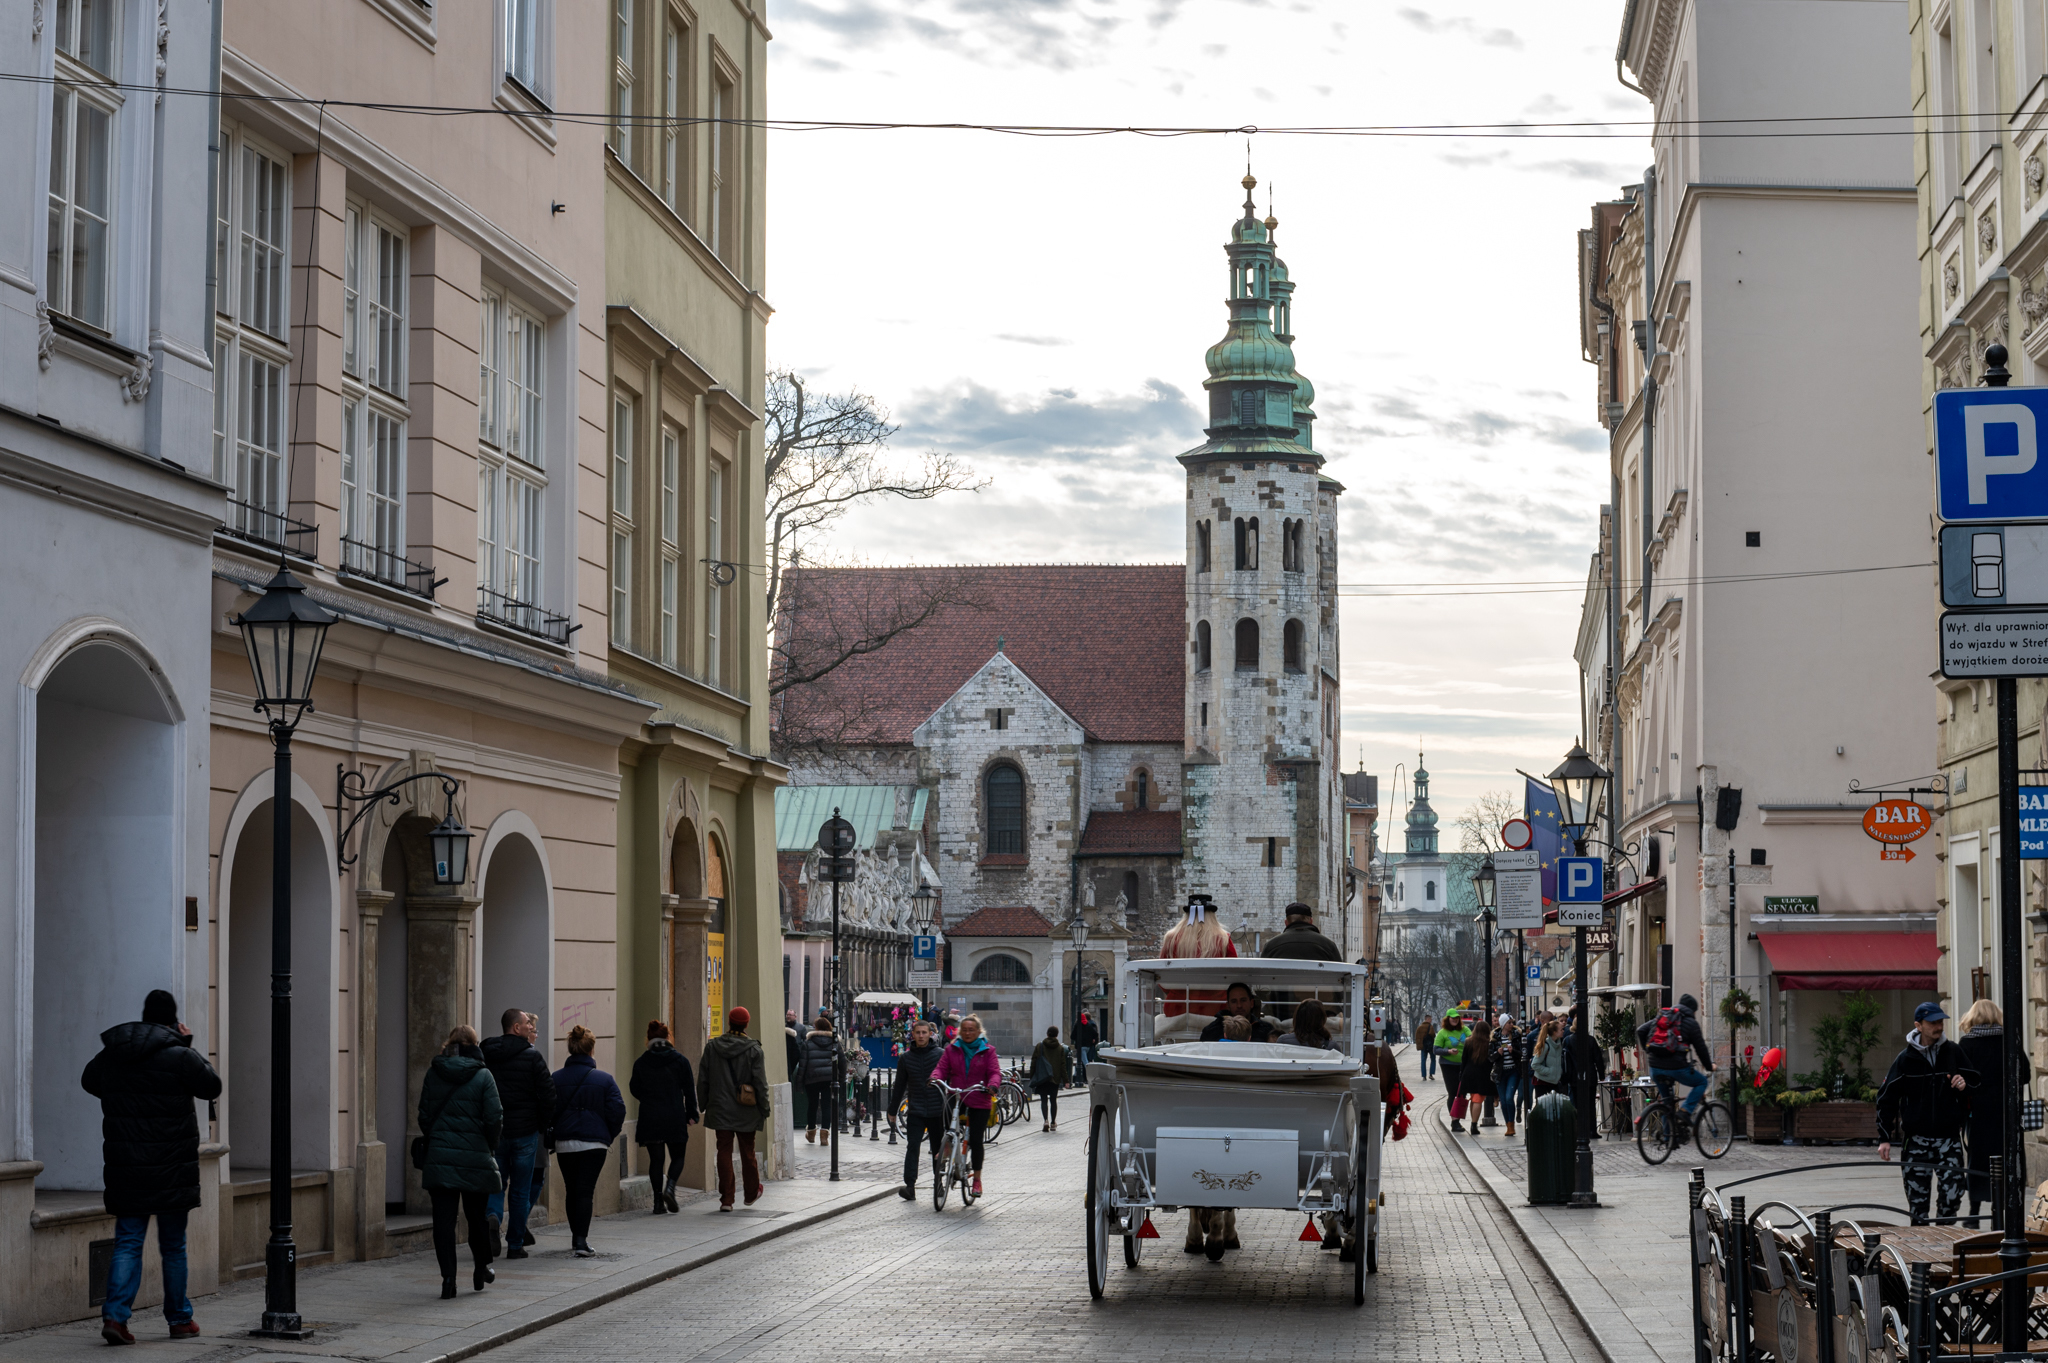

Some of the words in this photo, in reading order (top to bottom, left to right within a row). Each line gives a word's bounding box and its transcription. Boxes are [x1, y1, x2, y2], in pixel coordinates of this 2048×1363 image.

[1964, 404, 2038, 505] P
[1946, 622, 1970, 635] Wył.
[1974, 622, 1992, 632] dla
[1950, 640, 1963, 649] do
[1968, 639, 2005, 651] wjazdu
[1953, 656, 2007, 668] wyjątkiem
[1875, 806, 1922, 824] BAR
[1868, 824, 1927, 841] NALEŚNIKOWY
[2020, 840, 2044, 850] Pod
[1885, 852, 1897, 860] 30
[1568, 862, 1593, 897] P
[1560, 910, 1600, 920] Koniec
[1767, 904, 1816, 914] SENACKA
[1586, 932, 1610, 944] BAR
[918, 938, 931, 955] P
[1530, 967, 1538, 978] P
[288, 1250, 294, 1262] 5
